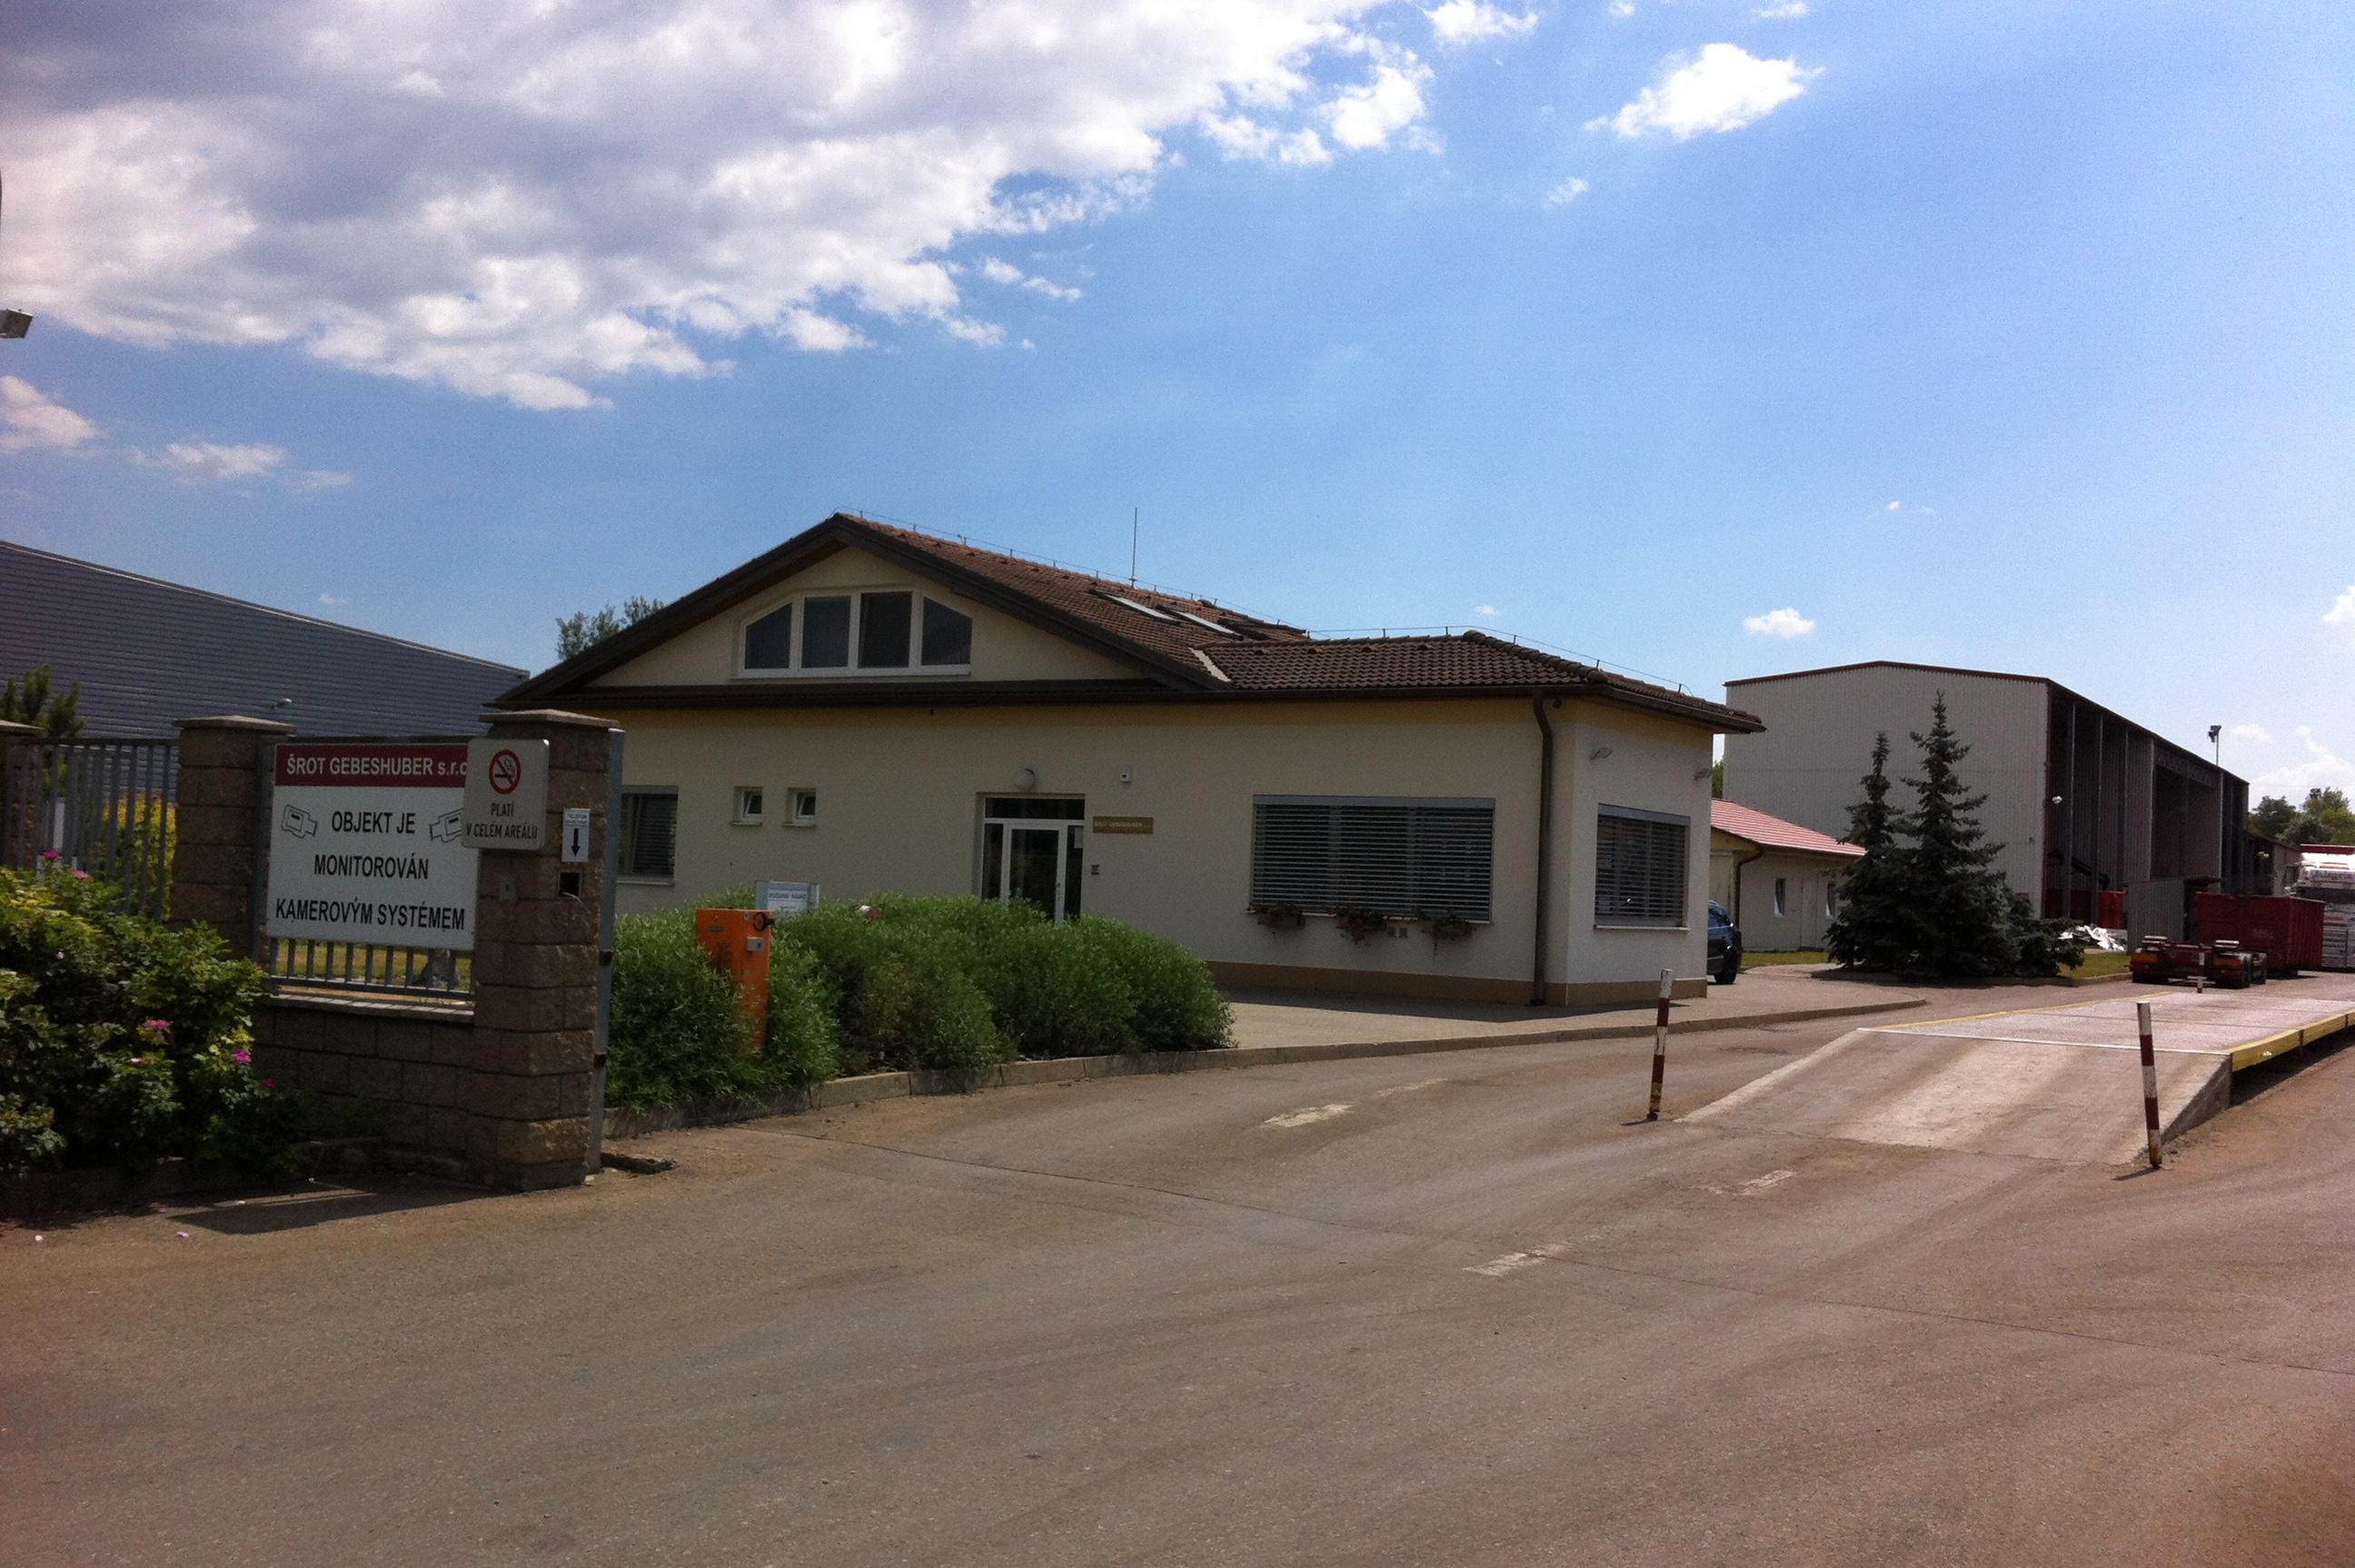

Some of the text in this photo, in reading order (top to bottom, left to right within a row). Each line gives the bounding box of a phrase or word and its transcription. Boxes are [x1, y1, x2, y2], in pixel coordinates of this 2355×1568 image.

[286, 753, 326, 775] ŠROT
[329, 757, 433, 776] GEBESHUBER
[491, 800, 515, 817] PLATÍ
[331, 810, 416, 835] OBJEKT JE
[465, 820, 539, 839] V CELÉM AREÁLU
[313, 852, 430, 880] MONITOROVÁN
[275, 897, 465, 930] KAMEROVÝM SYSTÉMEM
